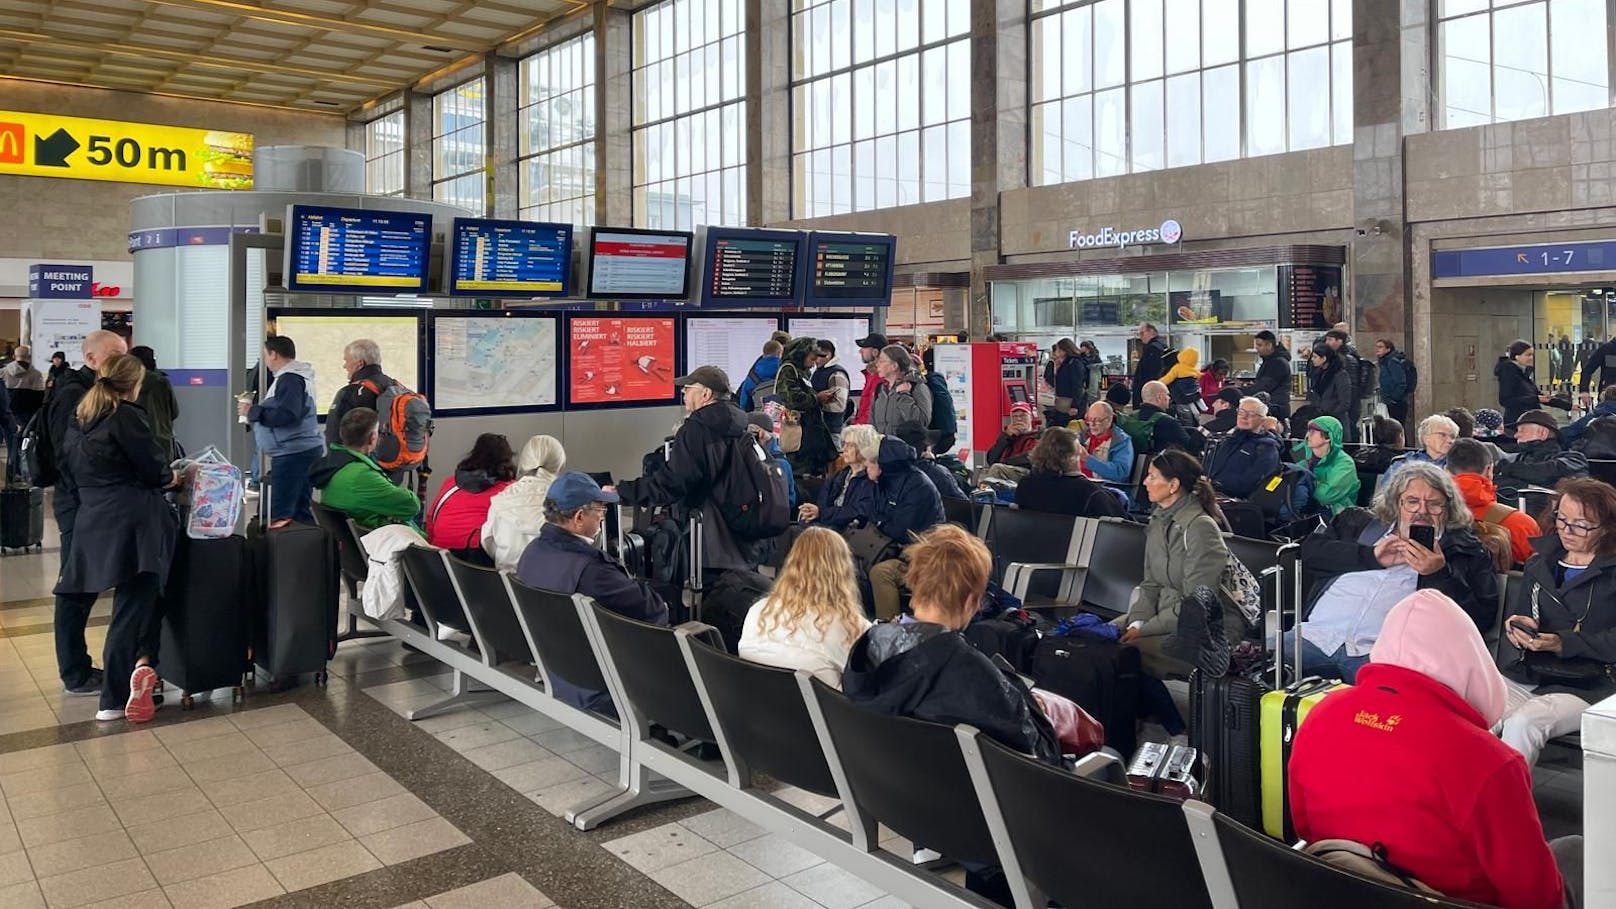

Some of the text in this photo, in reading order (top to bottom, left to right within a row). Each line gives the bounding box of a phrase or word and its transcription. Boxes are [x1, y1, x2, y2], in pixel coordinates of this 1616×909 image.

[87, 135, 187, 171] 50 m
[1070, 227, 1160, 249] FoodExpress
[44, 272, 89, 282] MEETING
[51, 283, 83, 292] POINT
